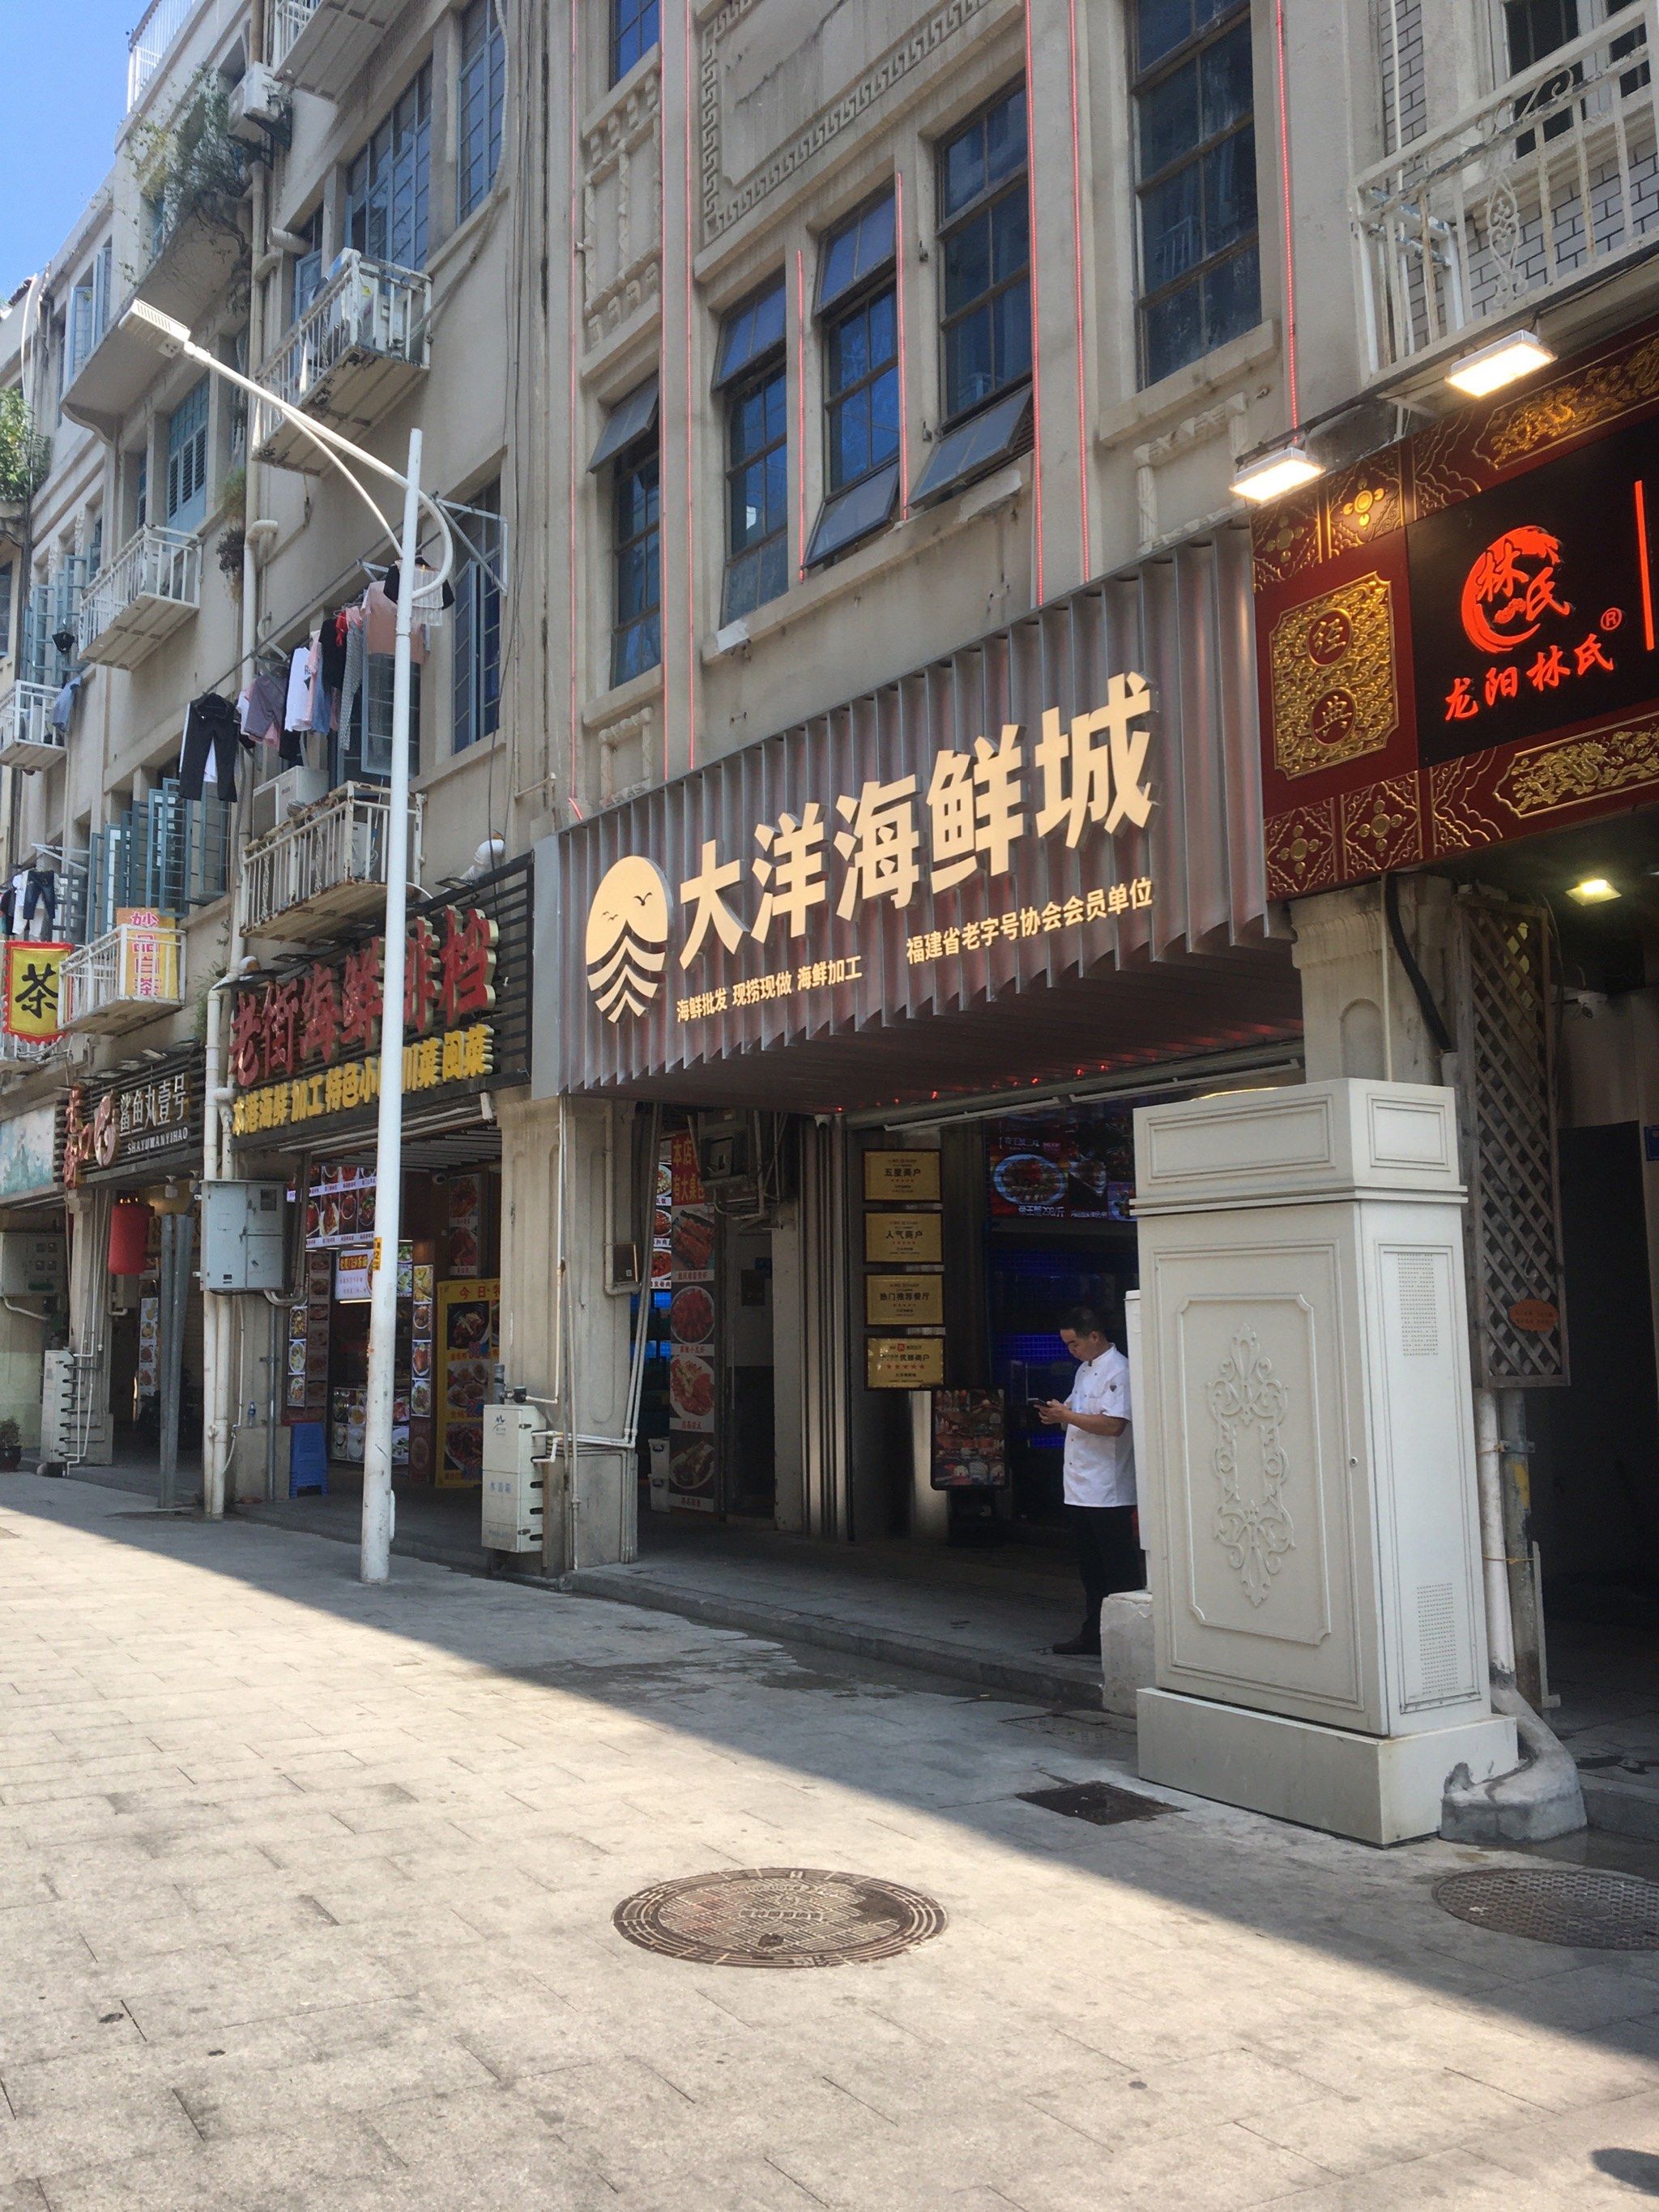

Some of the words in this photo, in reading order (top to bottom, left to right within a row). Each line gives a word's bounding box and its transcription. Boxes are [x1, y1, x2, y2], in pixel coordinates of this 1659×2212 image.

[1445, 634, 1614, 720] 龙阳林氏
[679, 671, 1158, 971] 大洋海鲜城
[906, 876, 1154, 965] 福建省老字号协会会员单位
[15, 962, 59, 1019] 茶
[676, 987, 728, 1023] 海鲜批发
[731, 972, 792, 1009] 现捞现做
[797, 954, 863, 993] 海鲜加工
[119, 1072, 186, 1137] 鲨鱼丸壹号
[291, 1074, 325, 1123] 加工
[127, 1126, 188, 1154] SHAYUWANYIHAO
